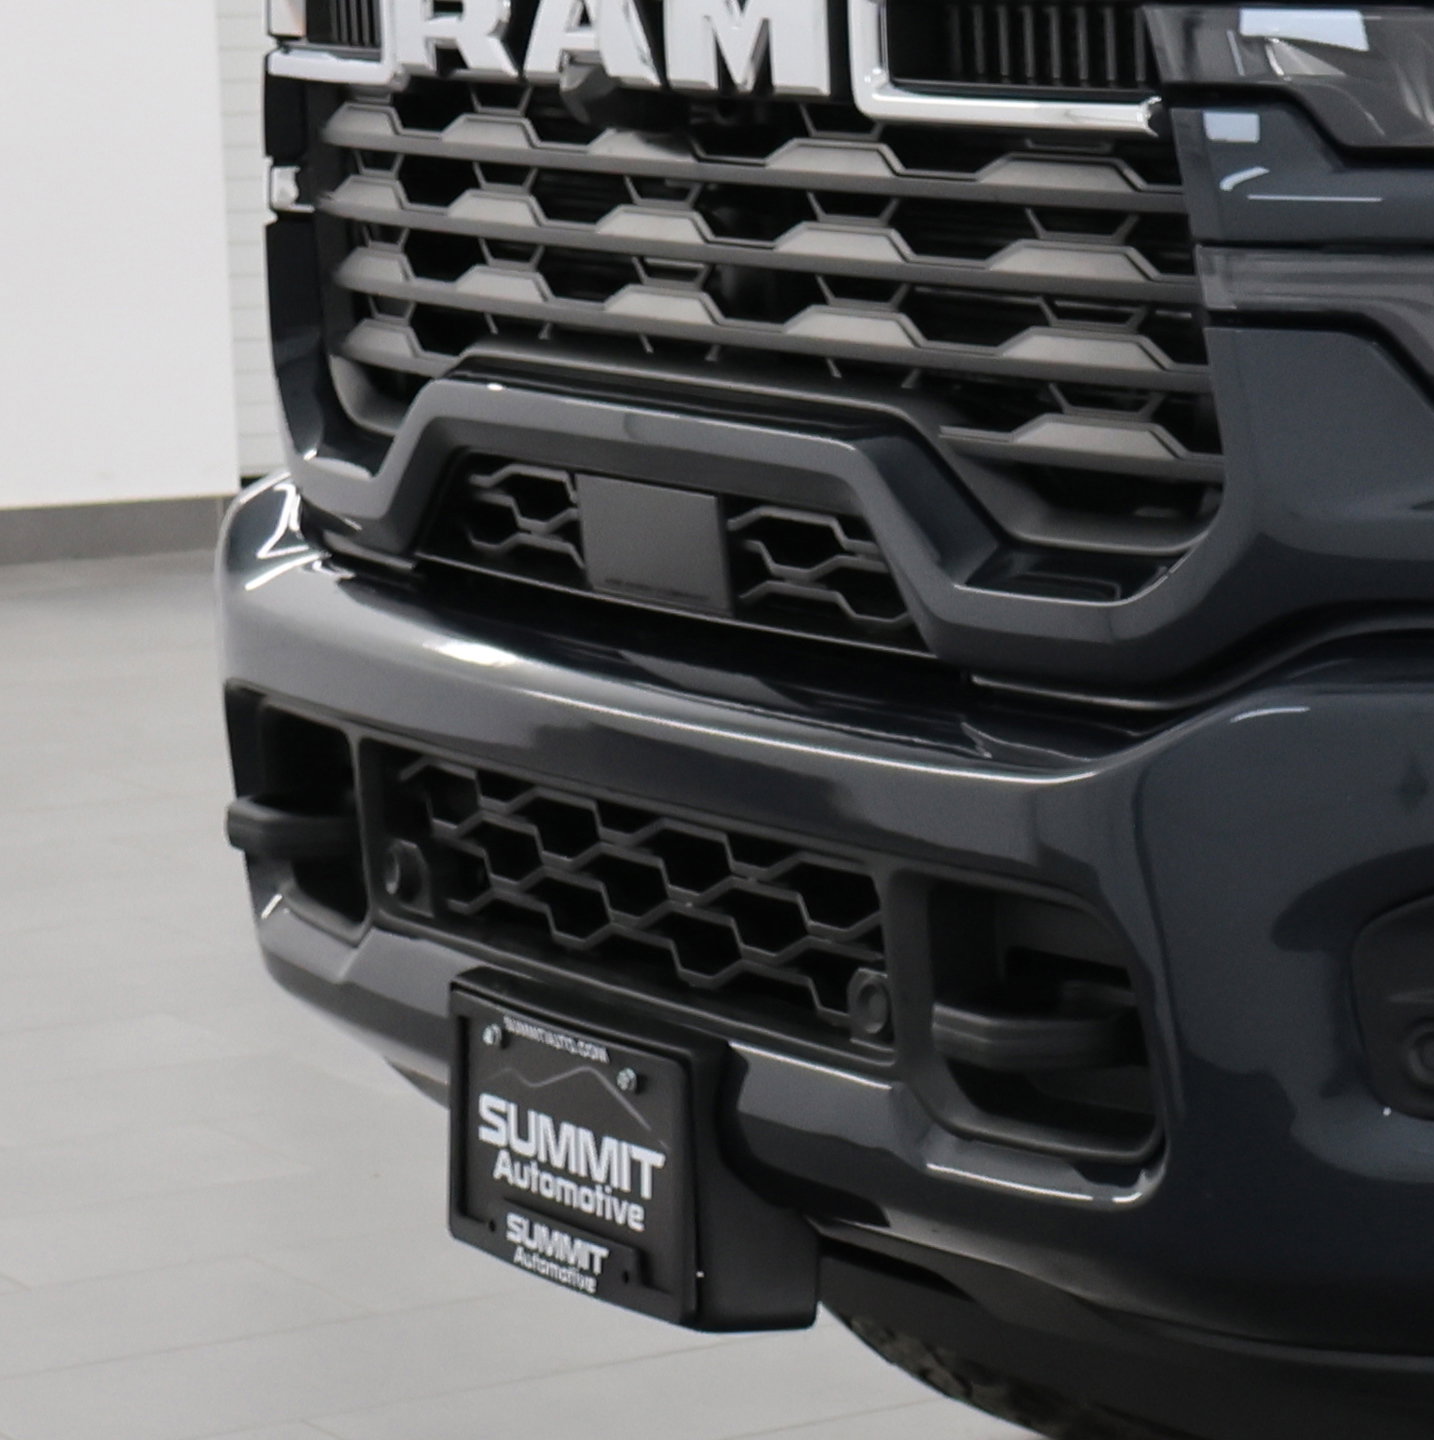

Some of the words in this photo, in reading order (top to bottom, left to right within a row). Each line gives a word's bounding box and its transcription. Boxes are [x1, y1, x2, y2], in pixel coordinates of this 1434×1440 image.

[478, 1093, 666, 1200] SUMMIT
[494, 1150, 646, 1232] Automotive
[506, 1212, 610, 1276] SUMMIT
[513, 1246, 598, 1294] Automotive
